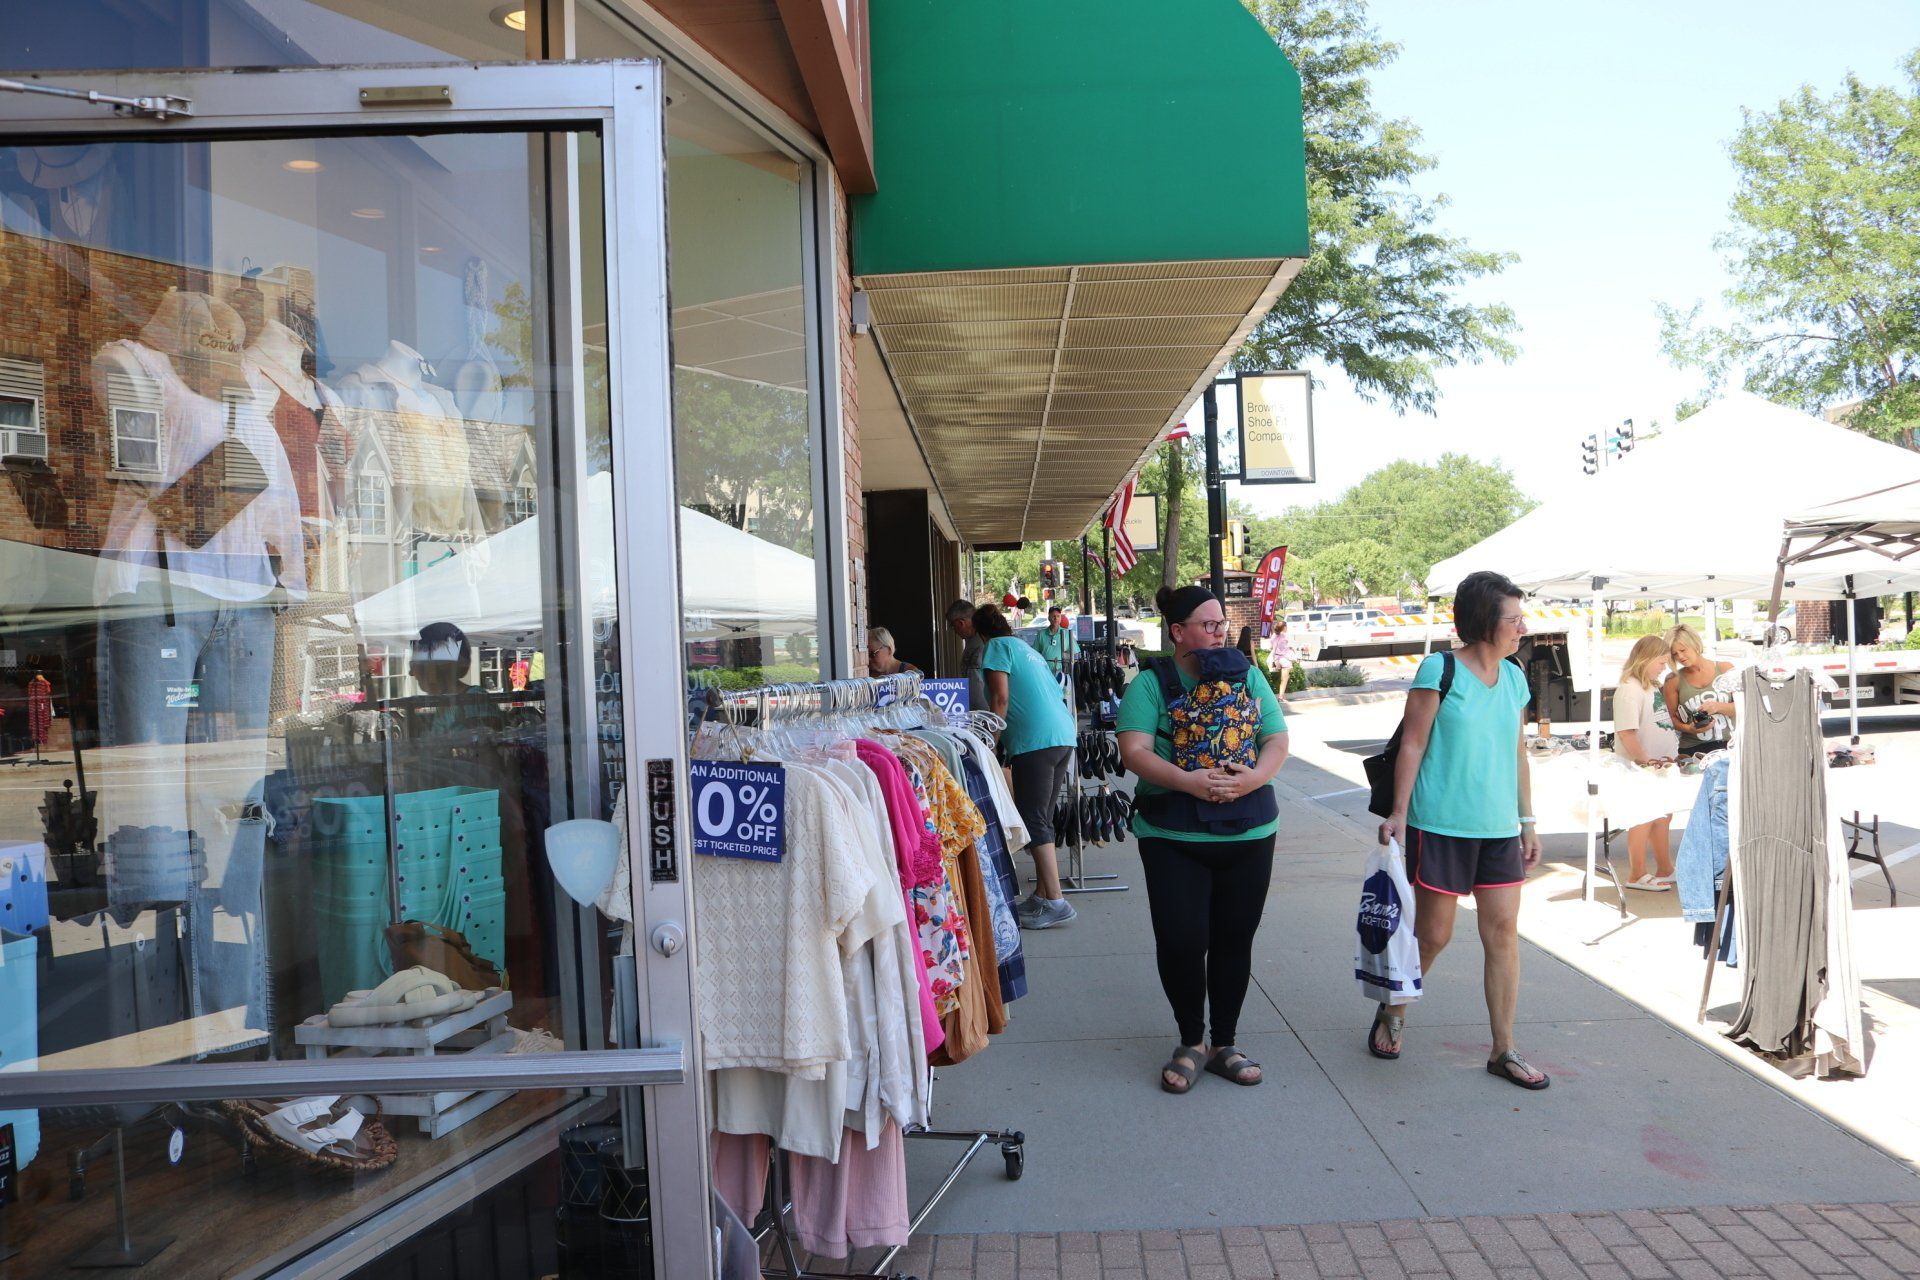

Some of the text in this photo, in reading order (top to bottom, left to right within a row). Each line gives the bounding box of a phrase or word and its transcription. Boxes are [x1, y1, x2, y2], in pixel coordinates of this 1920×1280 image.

[1248, 416, 1273, 428] Shoe
[1261, 469, 1295, 477] DOWNTOWN
[1260, 556, 1281, 637] OPEN
[690, 765, 707, 777] AN
[709, 766, 781, 785] ADDITIONAL
[697, 781, 778, 837] 0%
[653, 777, 673, 869] PUSH
[737, 822, 777, 843] OFF
[710, 840, 751, 853] TICKETED
[752, 845, 778, 856] PRICE
